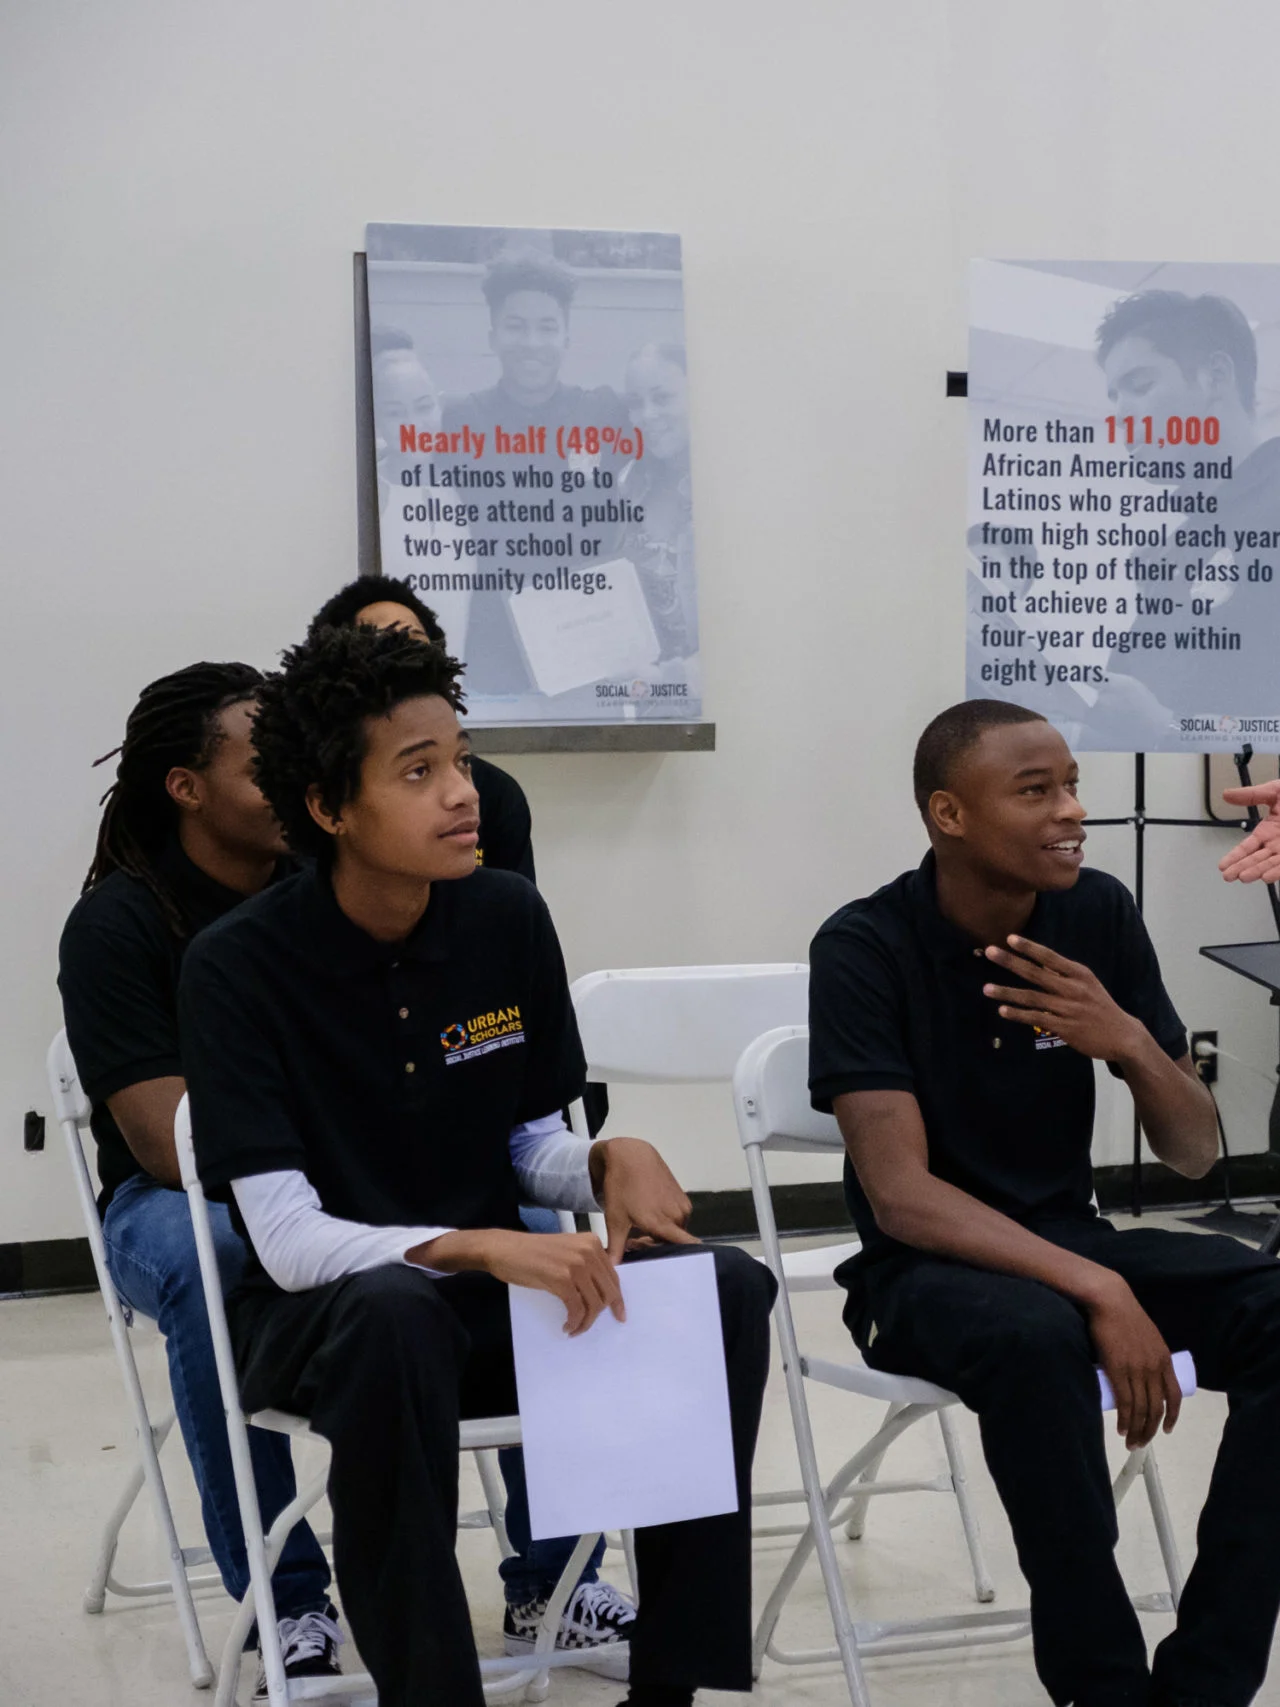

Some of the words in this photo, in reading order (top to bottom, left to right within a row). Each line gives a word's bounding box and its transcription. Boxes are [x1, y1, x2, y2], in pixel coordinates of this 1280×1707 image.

[400, 424, 485, 459] Nearly
[495, 425, 546, 454] half
[556, 426, 644, 460] (48%)
[984, 419, 1037, 442] More
[1045, 420, 1094, 443] than
[1105, 416, 1220, 448] 111,000
[401, 464, 421, 487] of
[429, 463, 506, 488] Latinos
[512, 465, 553, 488] who
[561, 471, 585, 493] go
[592, 467, 613, 488] to
[983, 453, 1061, 477] African
[1070, 454, 1185, 479] Americans
[1194, 456, 1232, 479] and
[403, 498, 478, 526] college
[487, 499, 554, 522] attend
[563, 505, 573, 522] a
[581, 499, 644, 527] public
[983, 487, 1061, 511] Latinos
[1070, 488, 1111, 512] who
[1120, 489, 1217, 517] graduate
[404, 534, 498, 560] two-year
[506, 533, 572, 557] school
[580, 539, 601, 556] or
[981, 522, 1033, 545] from
[1042, 522, 1088, 550] high
[1097, 523, 1166, 547] school
[1175, 524, 1225, 547] each
[1234, 531, 1280, 552] year
[406, 568, 524, 595] community
[533, 567, 612, 595] college.
[982, 555, 1001, 578] in
[1009, 555, 1044, 580] the
[1053, 558, 1087, 584] top
[1096, 558, 1117, 580] of
[1124, 557, 1177, 580] their
[1185, 558, 1239, 581] class
[1248, 559, 1273, 582] do
[982, 591, 1016, 613] not
[1025, 590, 1107, 614] achieve
[1116, 598, 1126, 614] a
[1135, 593, 1183, 615] two-
[1192, 599, 1214, 616] or
[981, 624, 1084, 652] four-year
[1092, 625, 1166, 653] degree
[1174, 626, 1240, 650] within
[981, 658, 1037, 686] eight
[1044, 665, 1108, 686] years.
[595, 684, 629, 697] SOCIAL
[650, 684, 688, 697] JUSTICE
[1181, 719, 1216, 732] SOCIAL
[1238, 720, 1279, 733] JUSTICE
[467, 1006, 520, 1033] URBAN
[469, 1021, 523, 1044] SCHOLARS
